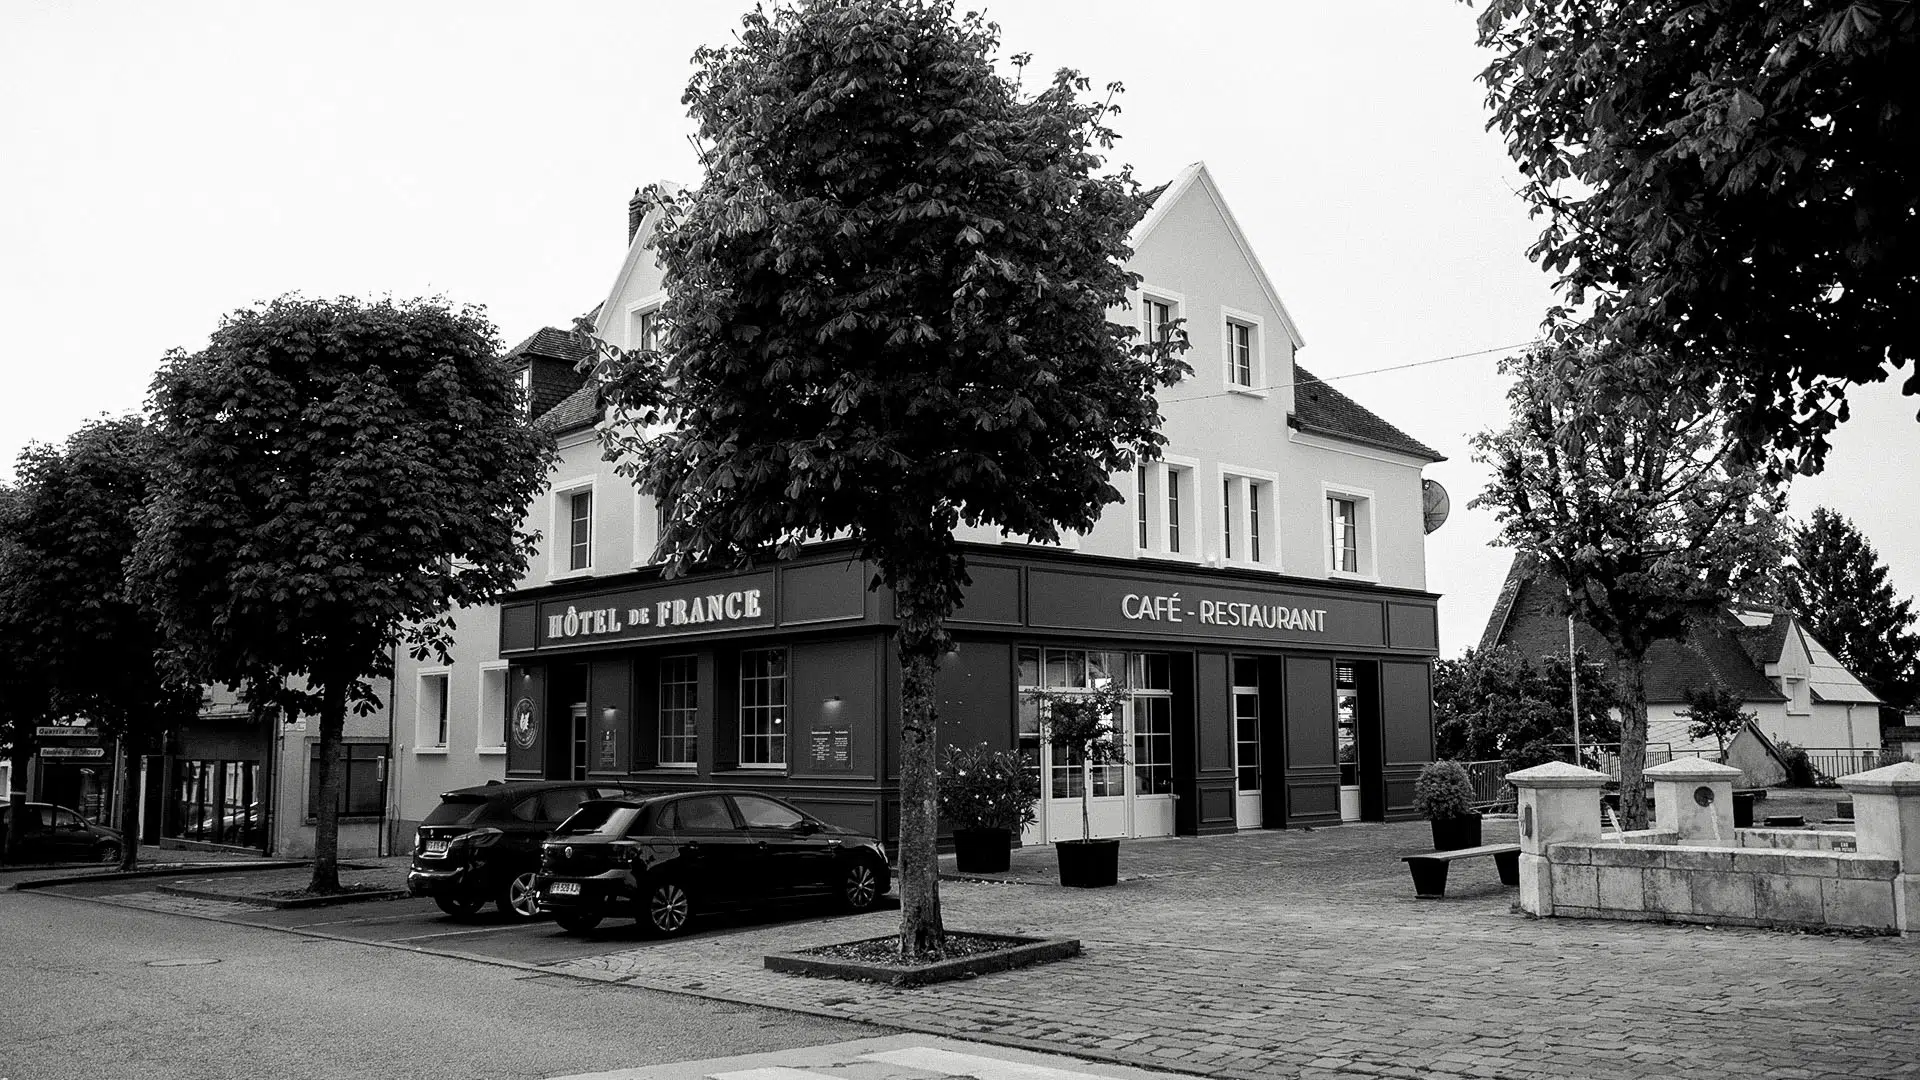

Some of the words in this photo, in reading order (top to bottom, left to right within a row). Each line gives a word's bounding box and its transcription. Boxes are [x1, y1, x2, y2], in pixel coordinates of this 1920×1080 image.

[548, 606, 621, 638] HÔTEL
[628, 607, 650, 625] DE
[656, 589, 761, 627] FRANCE
[1121, 592, 1182, 622] CAFÉ
[1199, 599, 1327, 632] RESTAURANT
